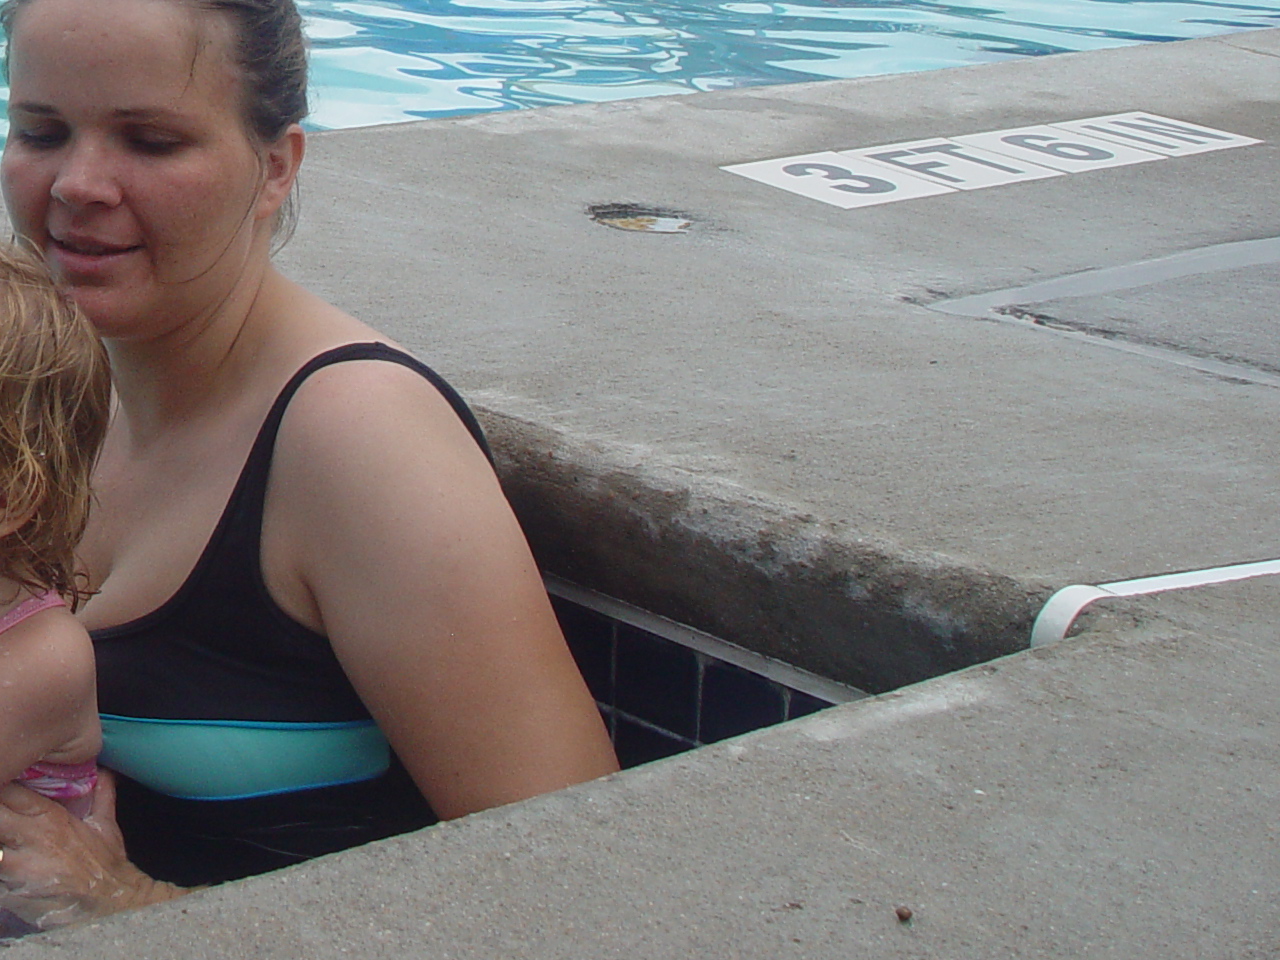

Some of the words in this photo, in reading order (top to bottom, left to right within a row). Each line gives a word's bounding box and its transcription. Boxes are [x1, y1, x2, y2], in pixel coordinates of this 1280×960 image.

[782, 163, 897, 194] 3
[865, 143, 1026, 183] FT
[1000, 134, 1114, 160] 6
[1081, 117, 1233, 149] IN
